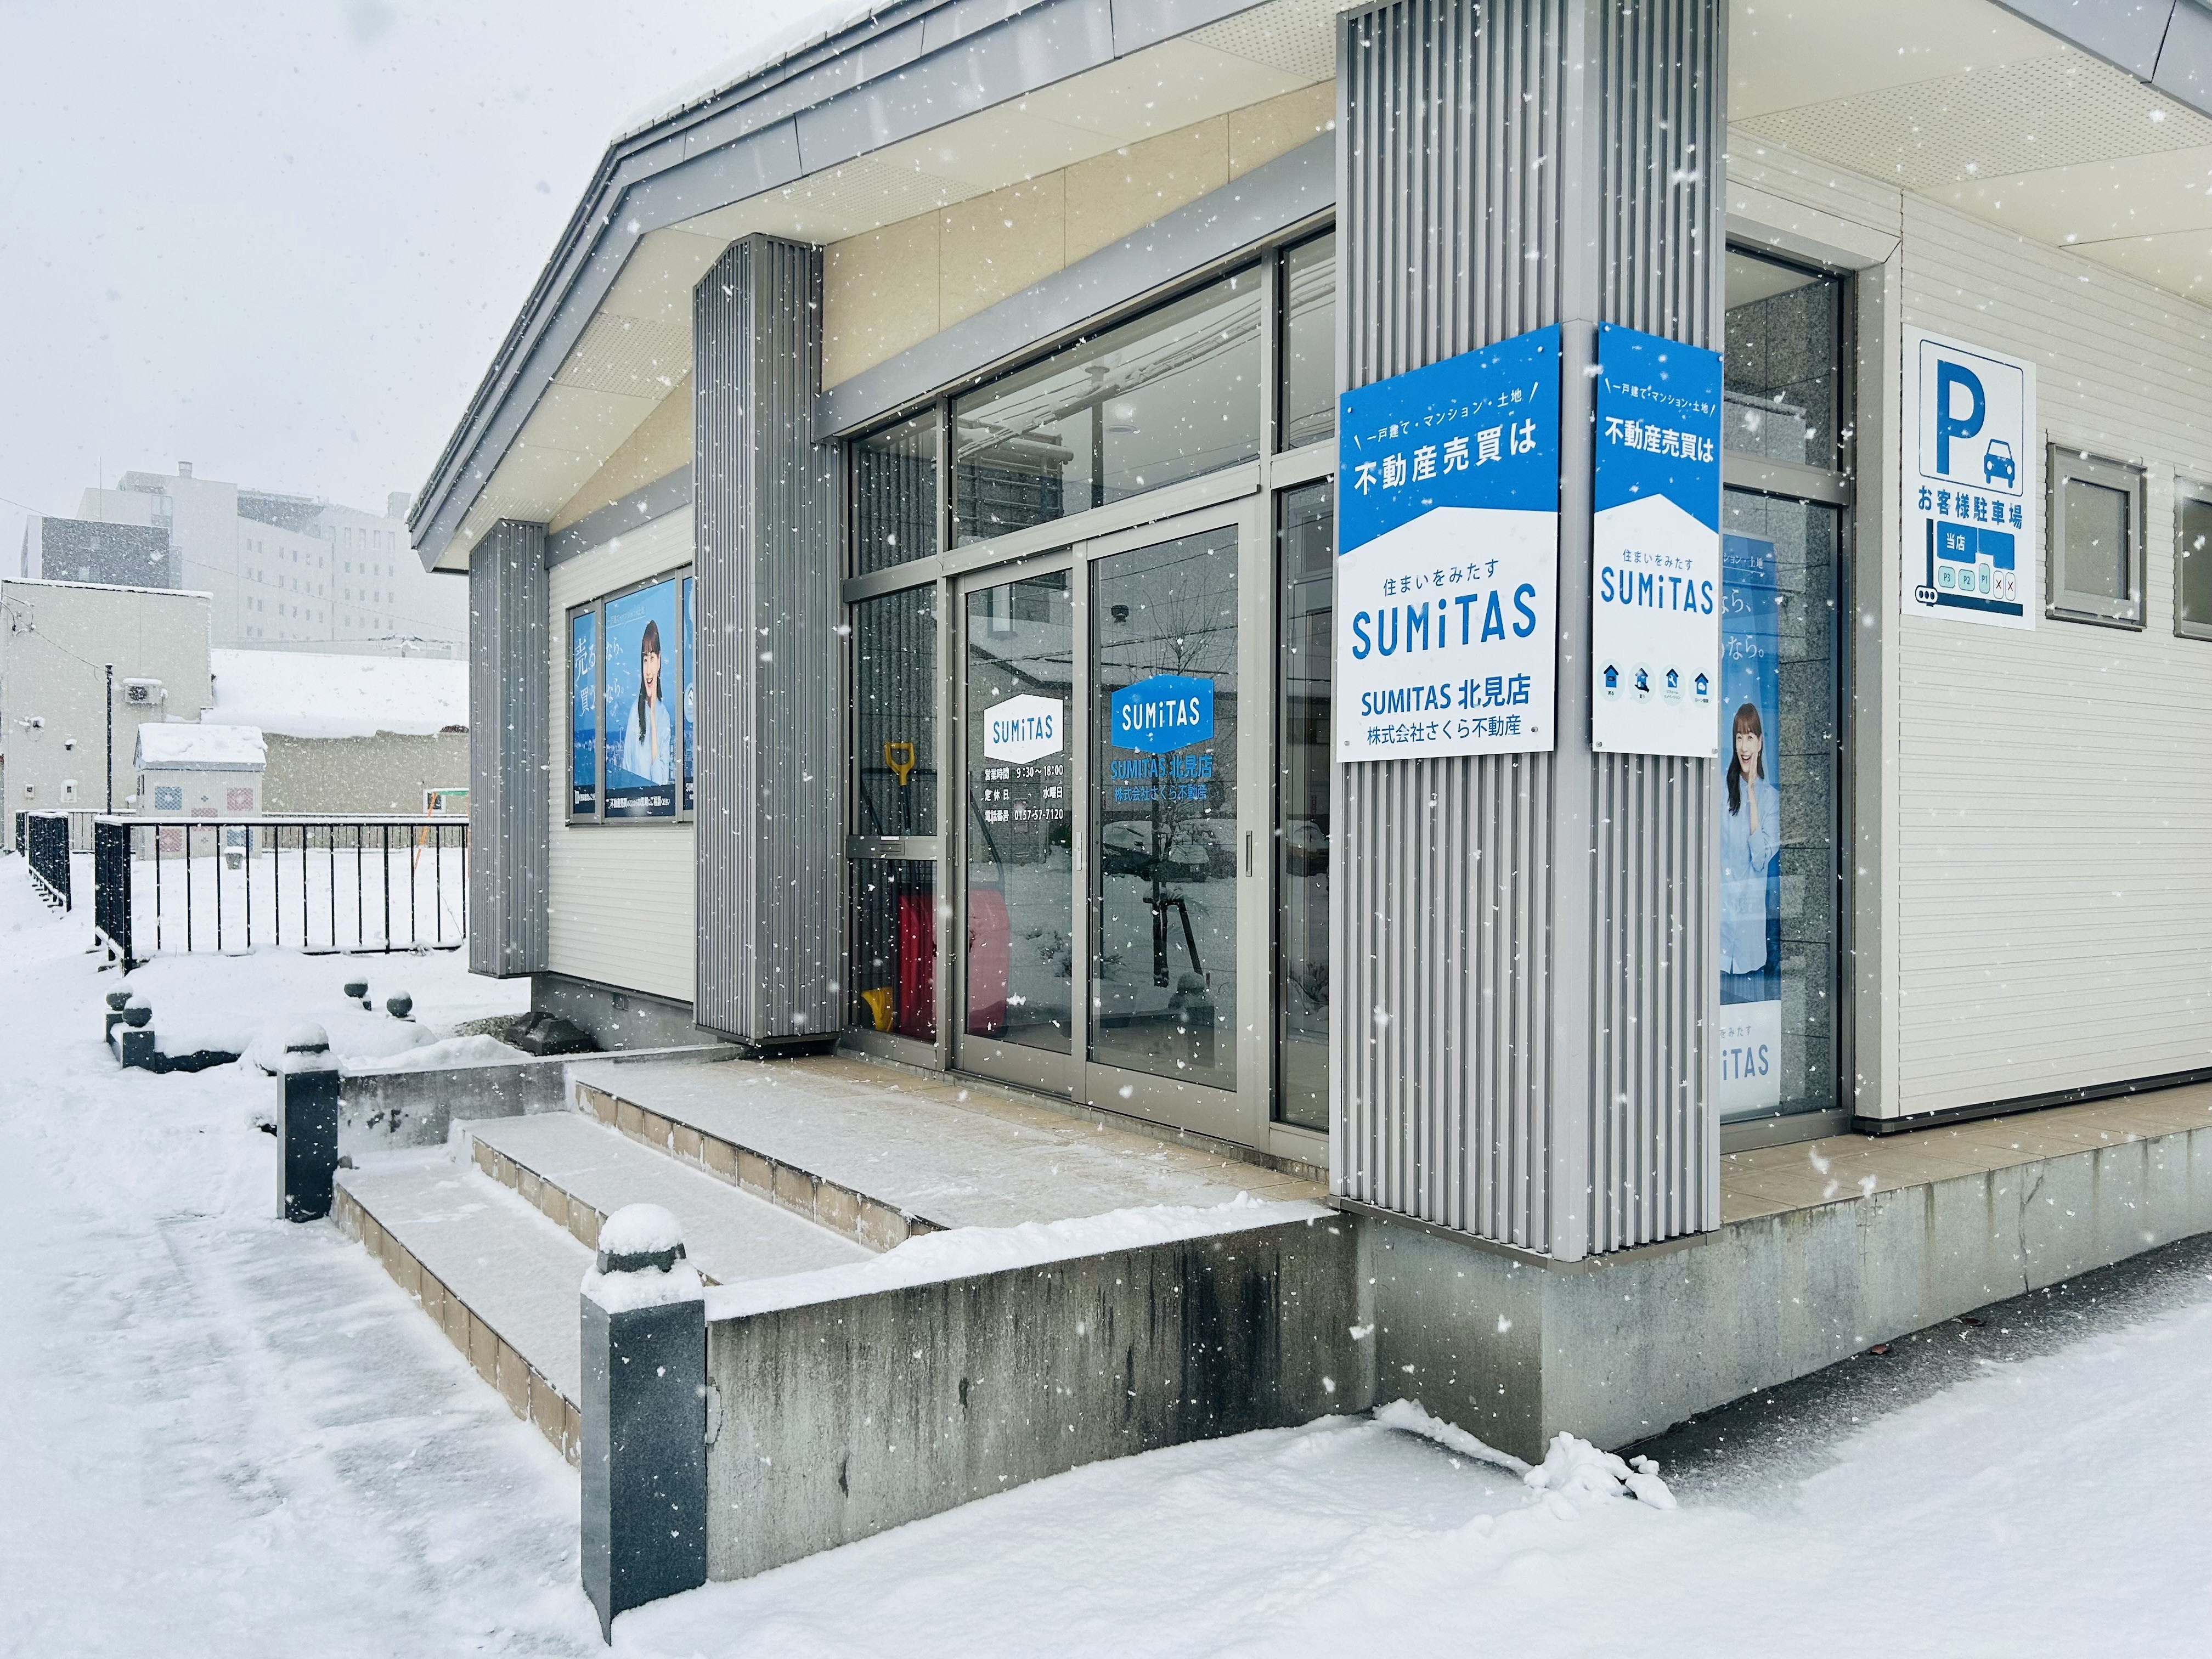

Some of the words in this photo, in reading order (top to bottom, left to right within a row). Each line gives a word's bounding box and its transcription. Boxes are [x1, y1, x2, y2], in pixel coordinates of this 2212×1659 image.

[1613, 383, 1708, 414] 一戸建て・マンション・土地
[1366, 387, 1522, 443] 一戸建て・マンション・土地
[1937, 359, 1986, 476] P
[1605, 416, 1714, 463] 不動産売買は
[1353, 417, 1537, 496] 不動産売買は
[1918, 485, 2023, 529] お客様駐車場
[1946, 532, 1966, 551] 当店
[1623, 549, 1693, 571] 住まいをみたす
[1383, 558, 1499, 597] 住まいをみたす
[1601, 566, 1713, 615] SUMiTAS
[1943, 572, 1951, 582] P3
[1963, 575, 1970, 585] P2
[1981, 574, 1988, 584] P1
[1352, 583, 1537, 660] SUMiTAS
[1361, 684, 1451, 716] SUMITAS
[1458, 673, 1531, 709] 北見店
[993, 715, 1053, 744] SUMiTAS
[1122, 697, 1200, 731] SUMiTAS
[1367, 714, 1521, 746] 株式会社さくら不動産
[984, 766, 1009, 781] 営業時間
[1110, 758, 1166, 780] SUMITAS
[1169, 753, 1213, 778] 北見店
[1042, 786, 1063, 799] 水曜日
[1114, 783, 1207, 802] 株式会社さくら不動産
[984, 809, 1009, 823] 電話番号
[1014, 808, 1063, 821] 0157-57-7120
